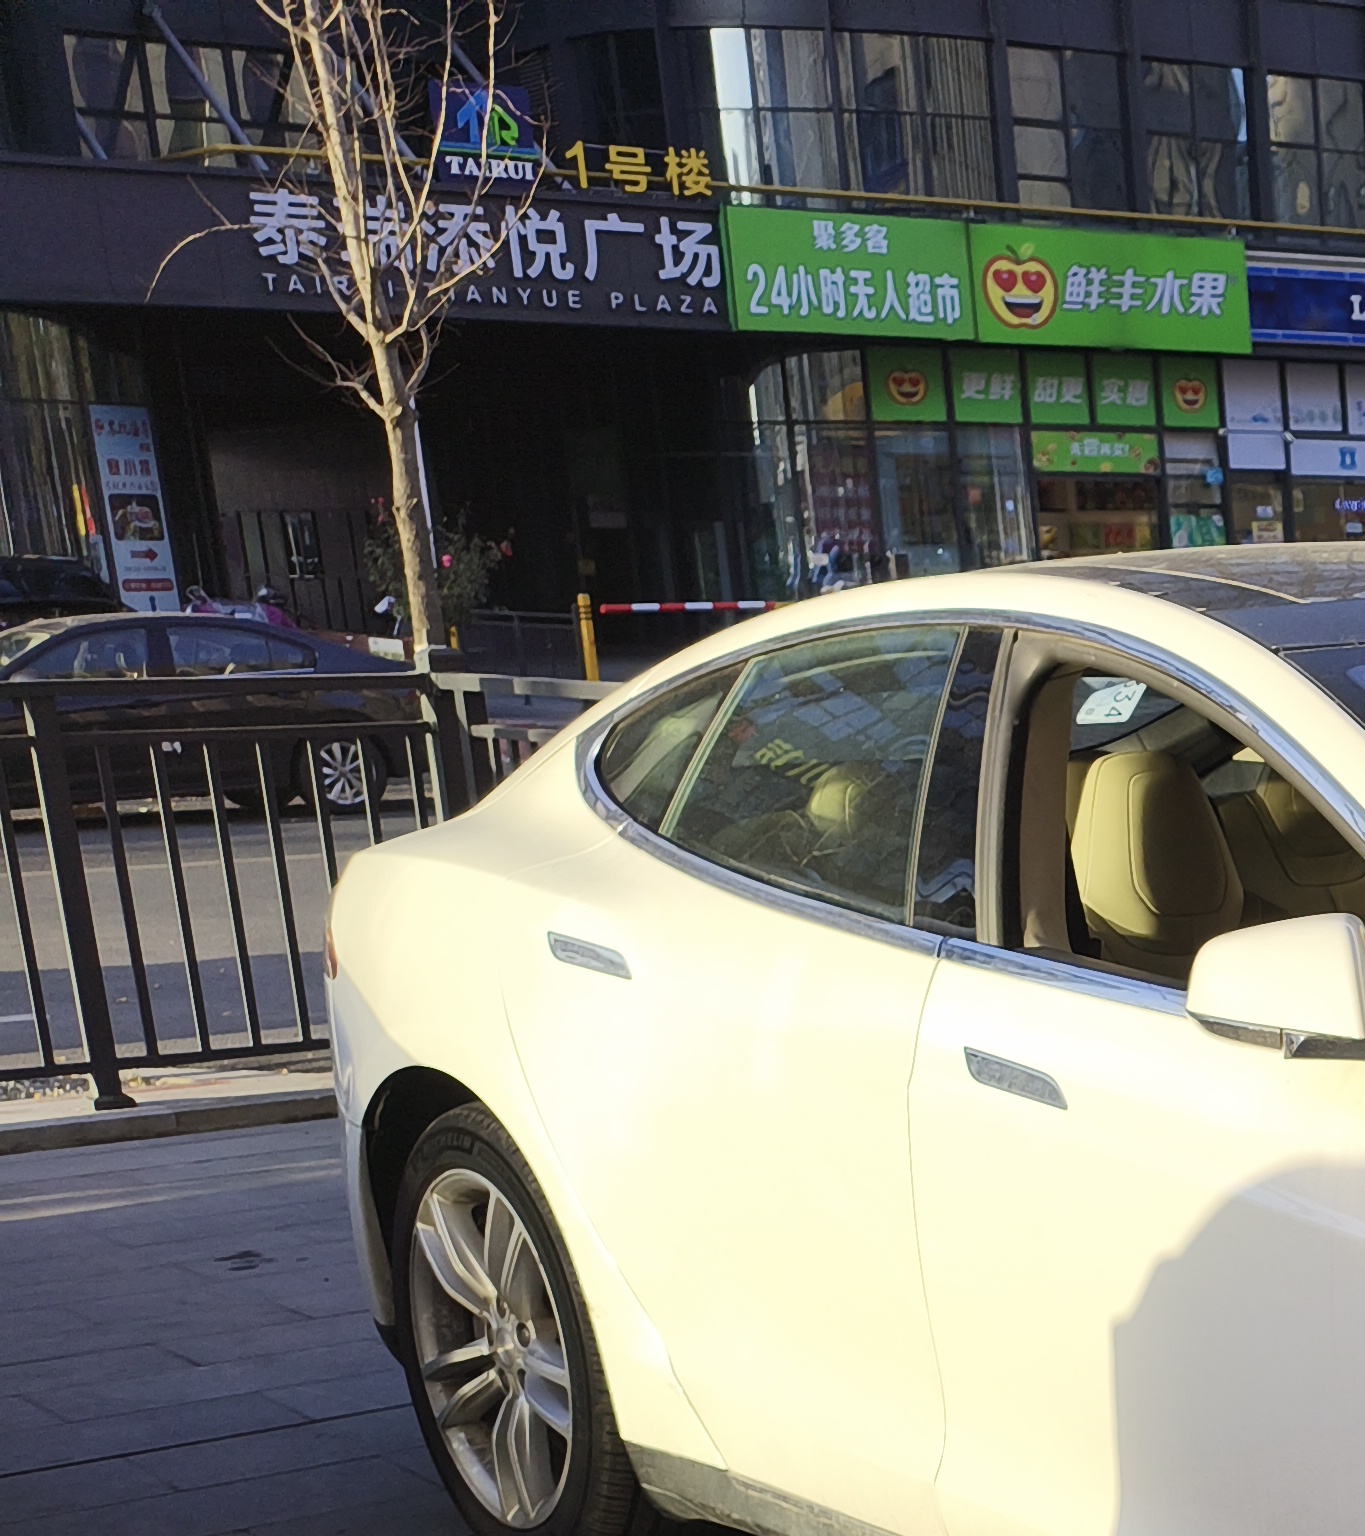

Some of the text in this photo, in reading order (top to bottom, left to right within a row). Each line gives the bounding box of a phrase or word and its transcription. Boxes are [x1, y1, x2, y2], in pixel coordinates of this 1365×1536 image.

[565, 140, 714, 197] 1号楼
[811, 219, 890, 255] 聚多客
[610, 291, 718, 314] PLAZA
[746, 263, 962, 325] 24小时无人超市
[1062, 264, 1228, 317] 鲜丰水果
